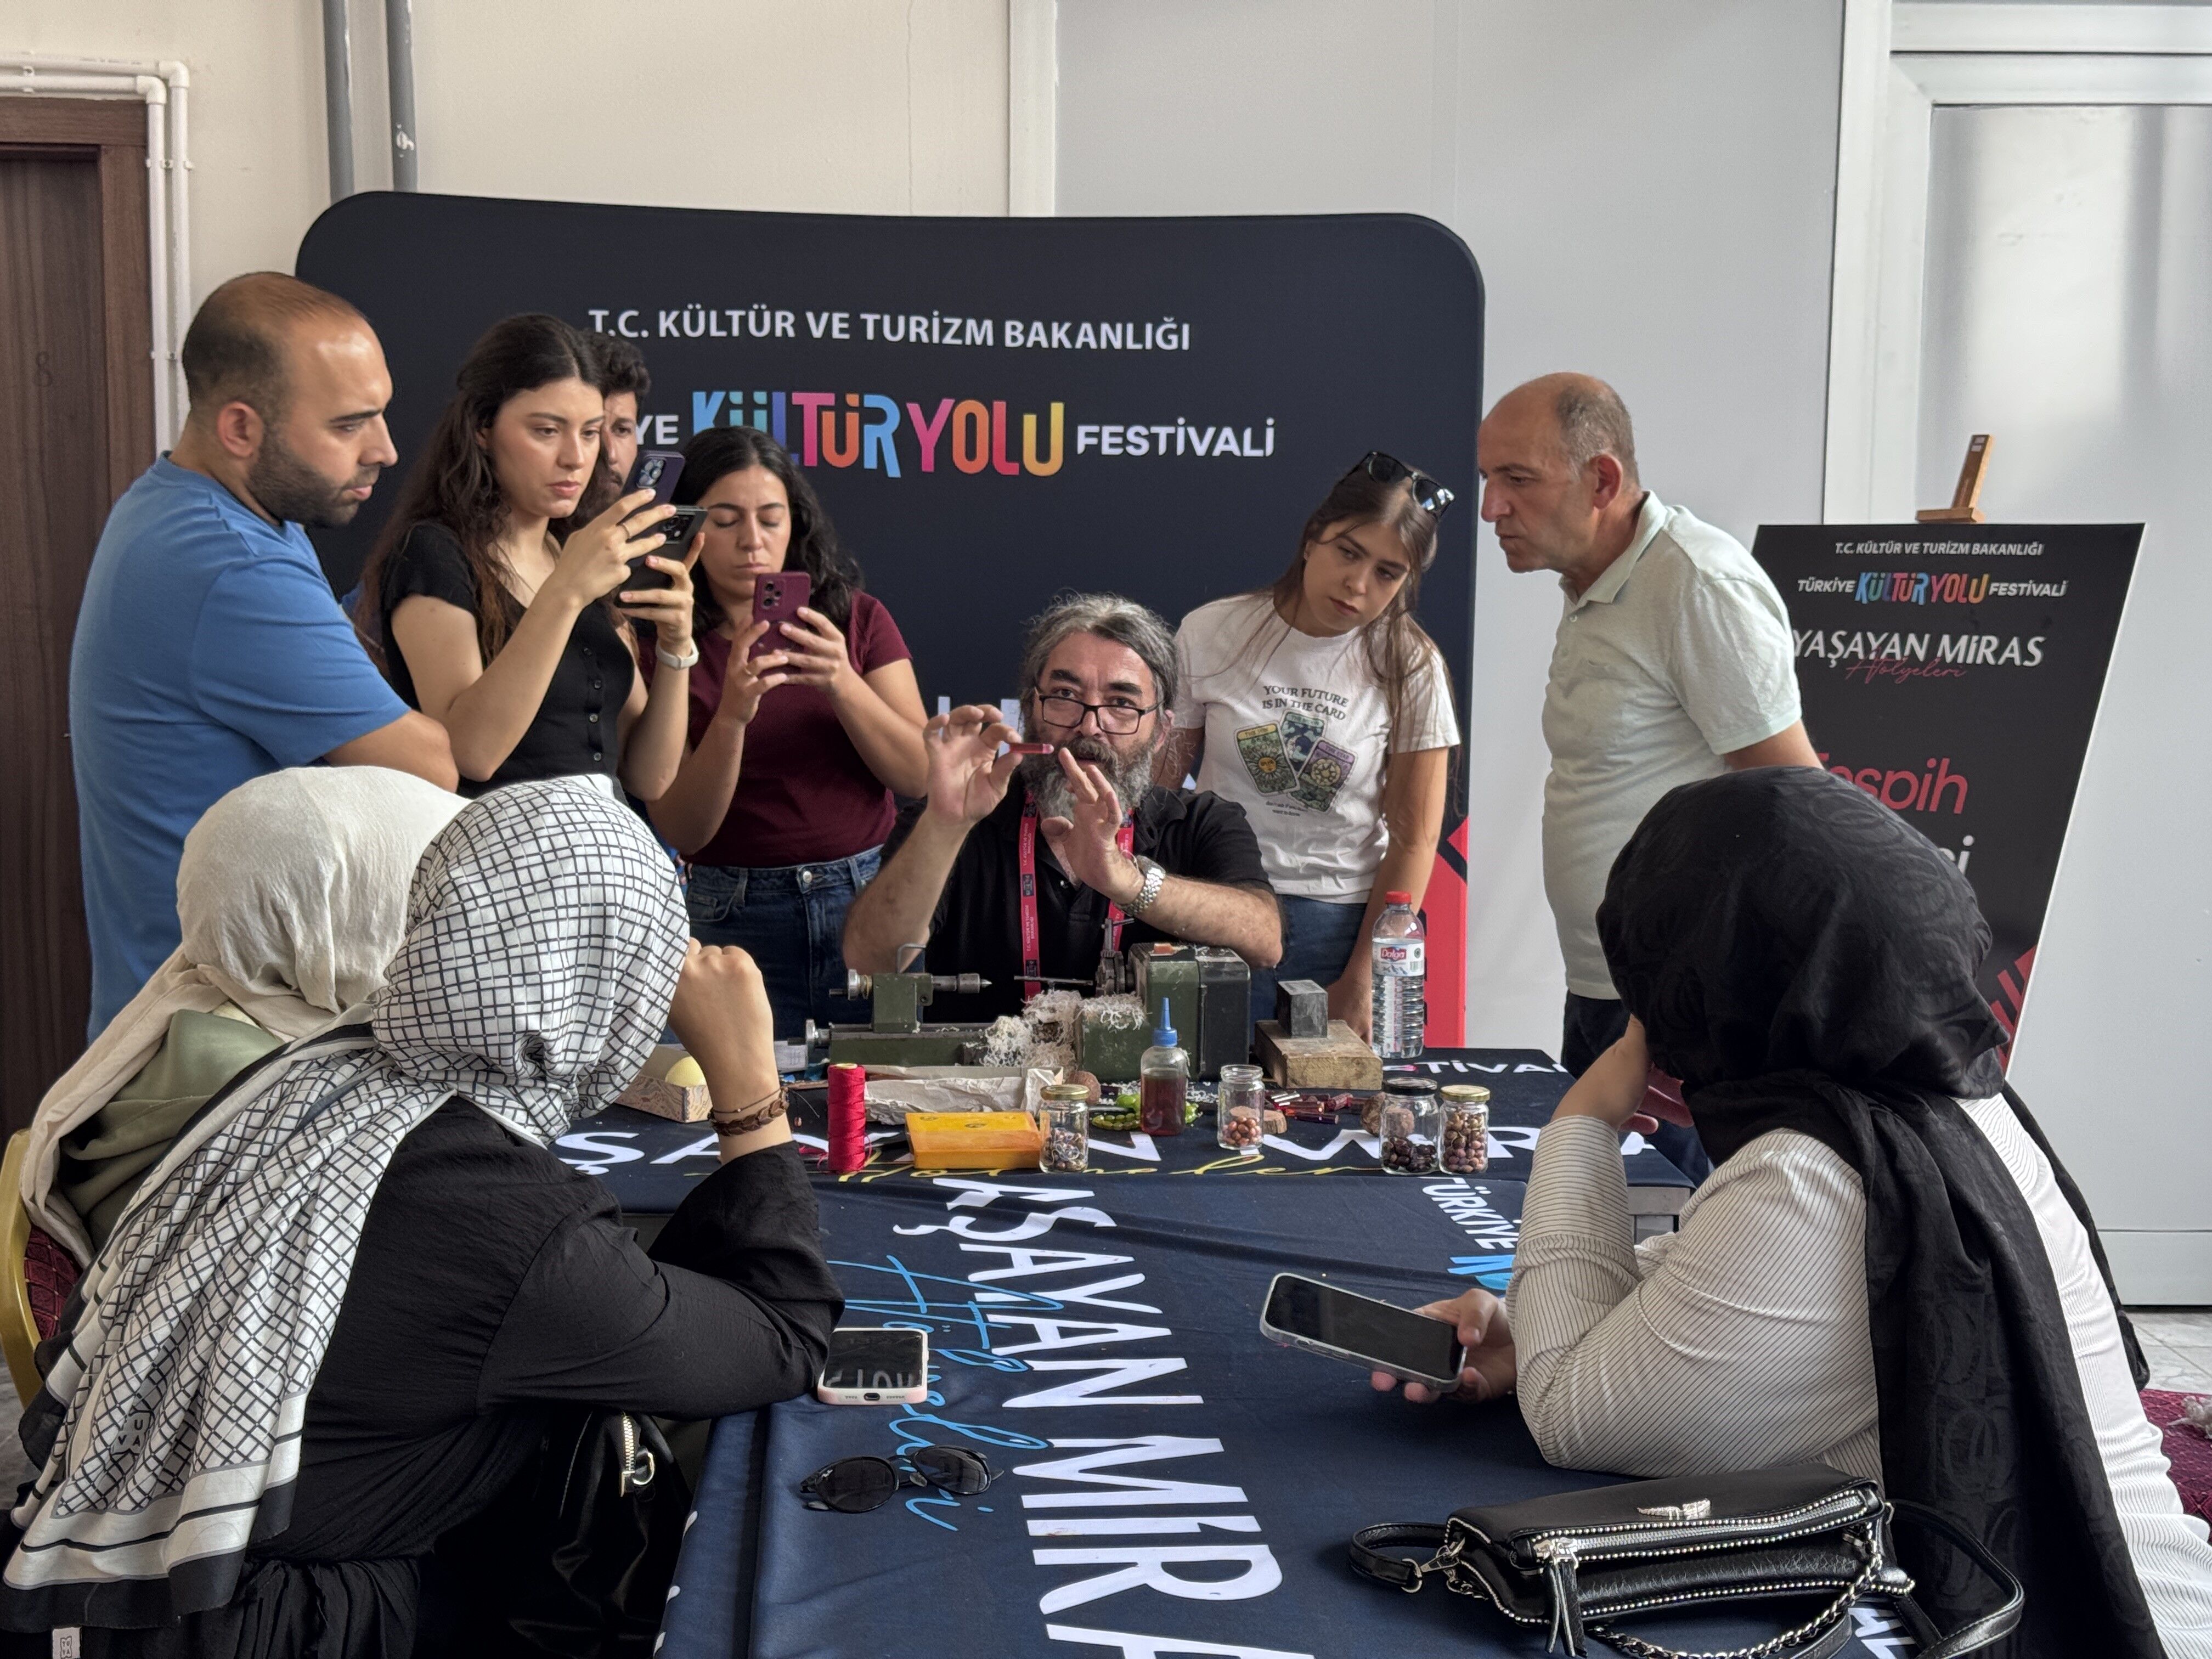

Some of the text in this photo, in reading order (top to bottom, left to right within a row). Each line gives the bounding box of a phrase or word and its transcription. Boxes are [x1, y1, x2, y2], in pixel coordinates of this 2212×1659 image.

[589, 303, 1190, 351] T.C. KÜLTÜR VE TURİZM BAKANLIĞI
[906, 398, 1064, 476] YOLU
[1077, 417, 1274, 457] FESTİVALİ
[1835, 540, 2042, 556] T.C. KÜLTÜR VE TURİZM BAKANLIĞI
[1798, 572, 2067, 605] TÜRKİYE KÜLTÜR YOLU FESTİVALİ
[1793, 630, 2045, 668] YAŞAYAN MİRAS
[1262, 698, 1346, 720] IS IN THE CARD
[1263, 685, 1348, 707] YOUR FUTURE
[1818, 753, 1968, 814] spih
